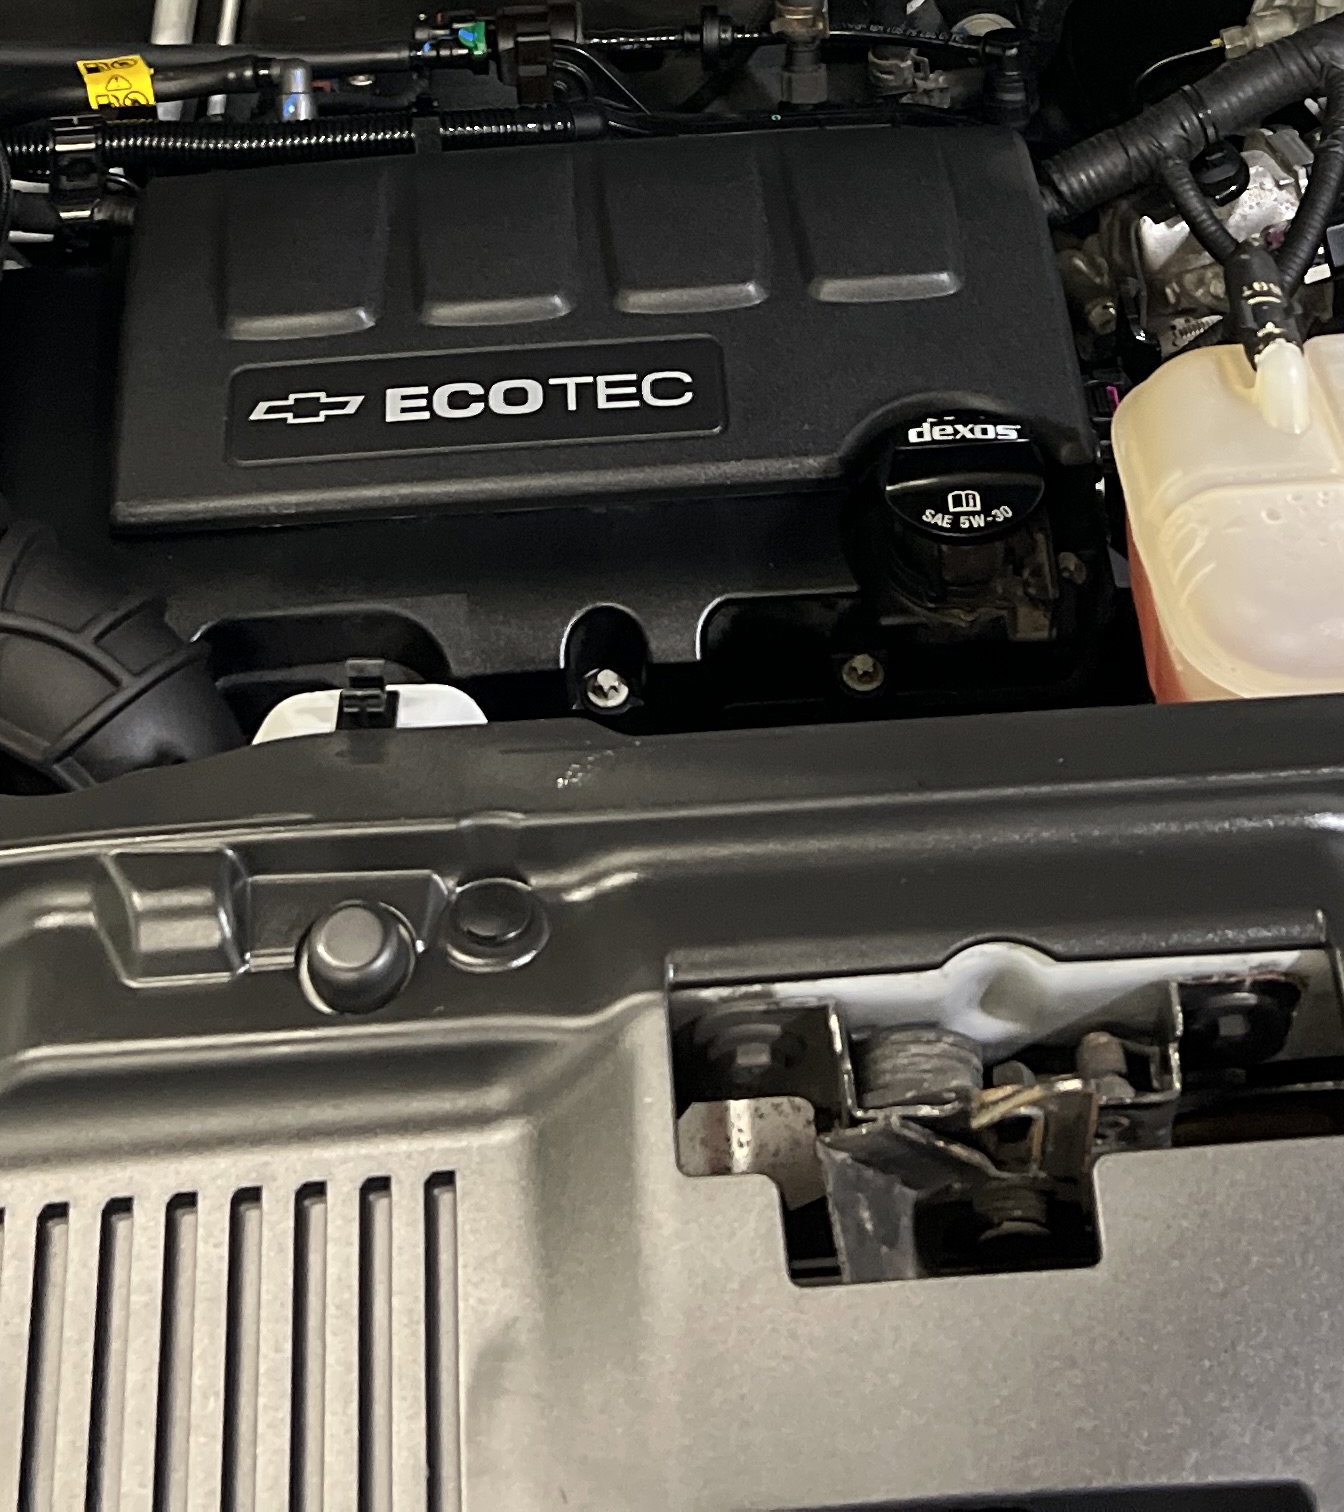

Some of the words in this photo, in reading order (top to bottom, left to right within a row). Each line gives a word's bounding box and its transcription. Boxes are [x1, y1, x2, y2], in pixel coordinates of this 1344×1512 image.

[385, 370, 694, 423] ECOTEC
[907, 422, 1022, 444] dexos
[921, 508, 954, 529] SAE
[959, 505, 1013, 529] 5W-30
